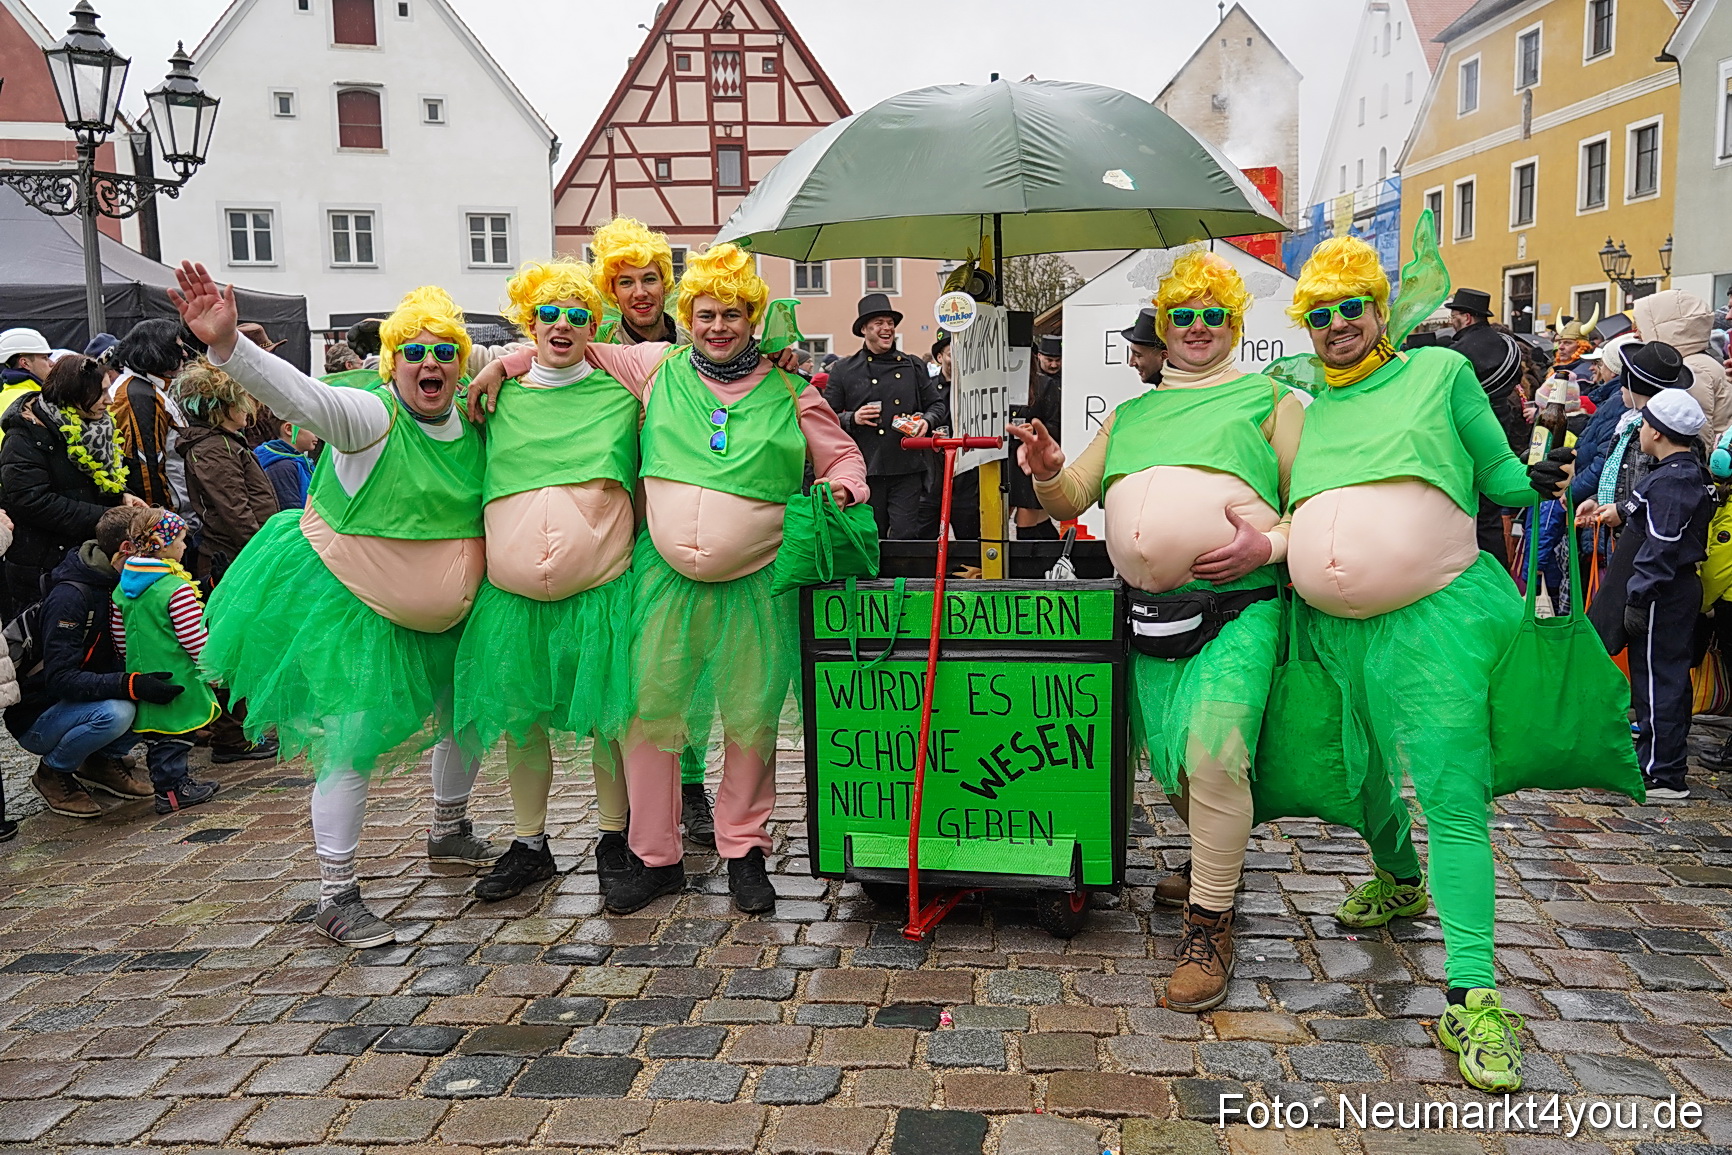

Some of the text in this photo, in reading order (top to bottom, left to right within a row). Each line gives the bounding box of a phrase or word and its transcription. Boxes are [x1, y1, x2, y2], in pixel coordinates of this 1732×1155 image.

[938, 311, 973, 323] Winkler
[825, 594, 1081, 636] OHNE BAUERN
[968, 673, 1012, 716] ES
[1032, 673, 1099, 719] UNS
[829, 723, 1095, 800] SCHÖNE WESEN
[831, 780, 915, 821] NICHT
[938, 807, 1053, 847] GEBEN
